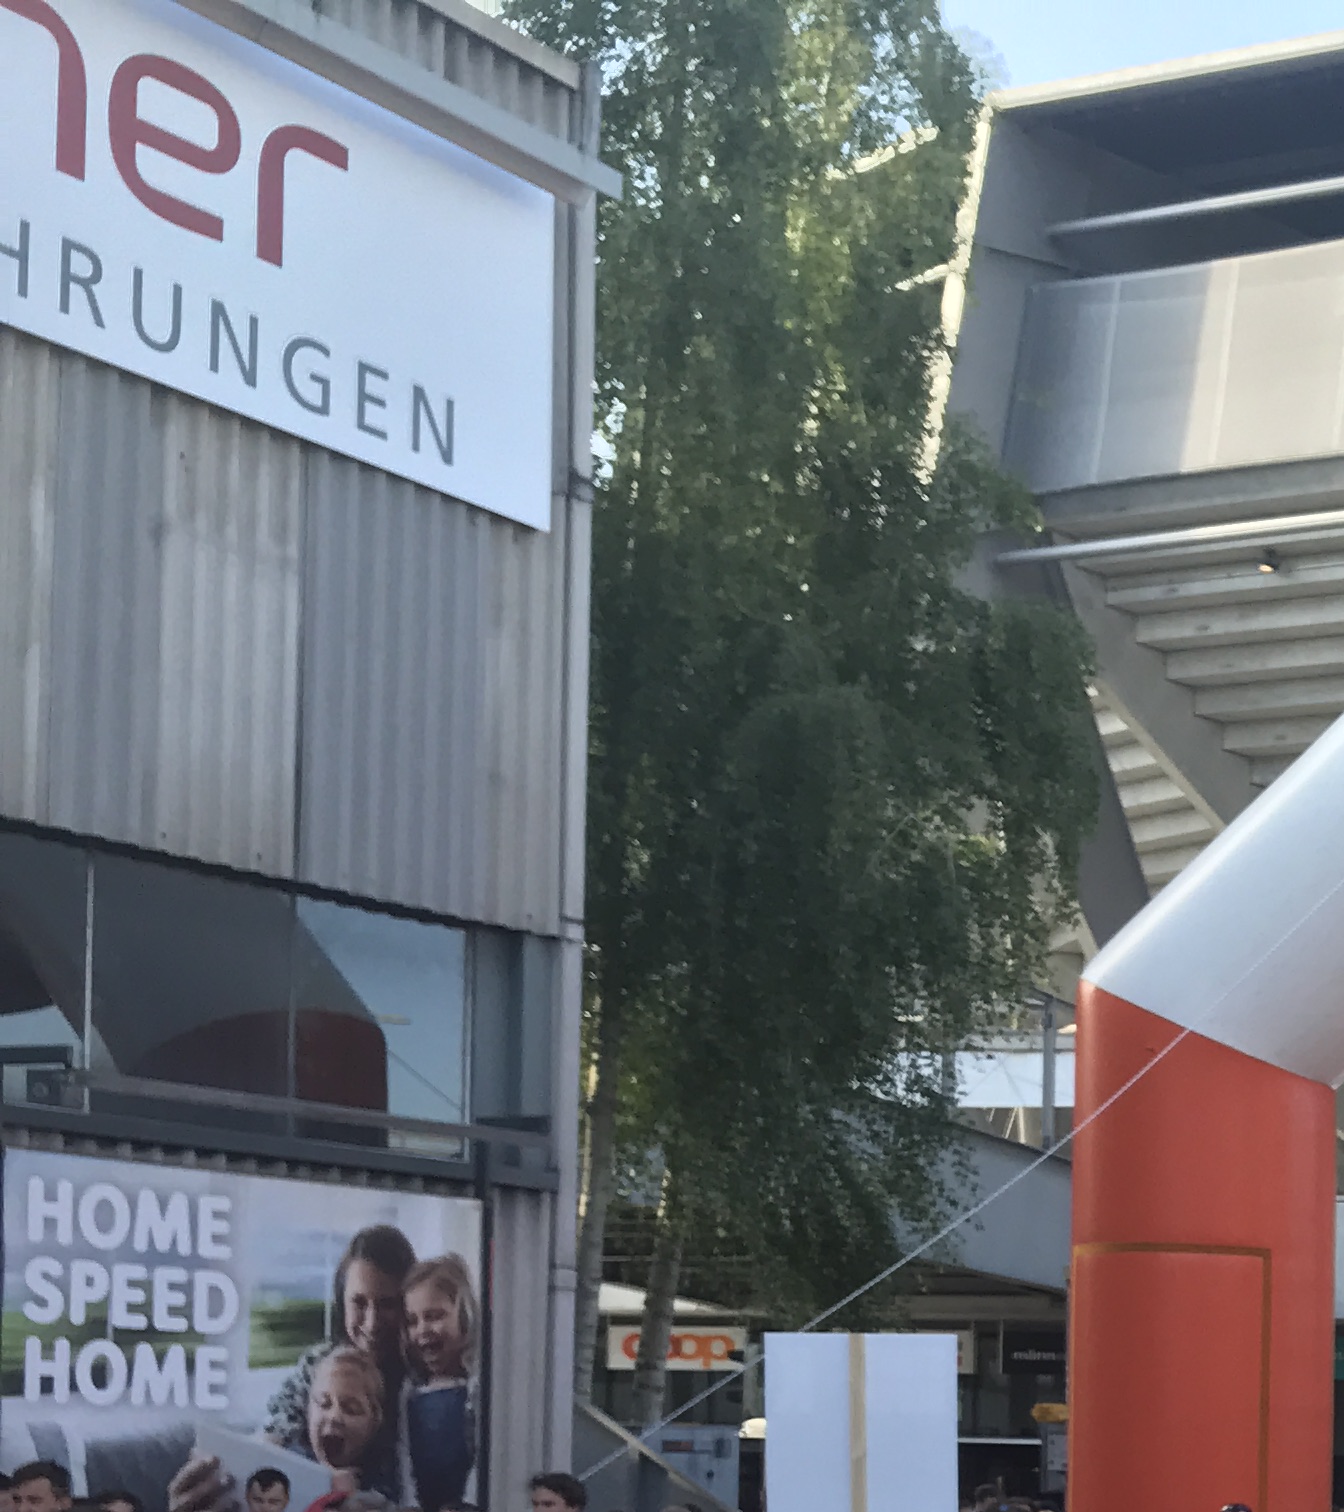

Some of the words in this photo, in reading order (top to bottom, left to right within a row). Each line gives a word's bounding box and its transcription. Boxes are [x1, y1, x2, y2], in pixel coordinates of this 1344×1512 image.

[26, 1175, 234, 1260] HOME
[22, 1257, 240, 1335] SPEED
[23, 1336, 230, 1410] HOME
